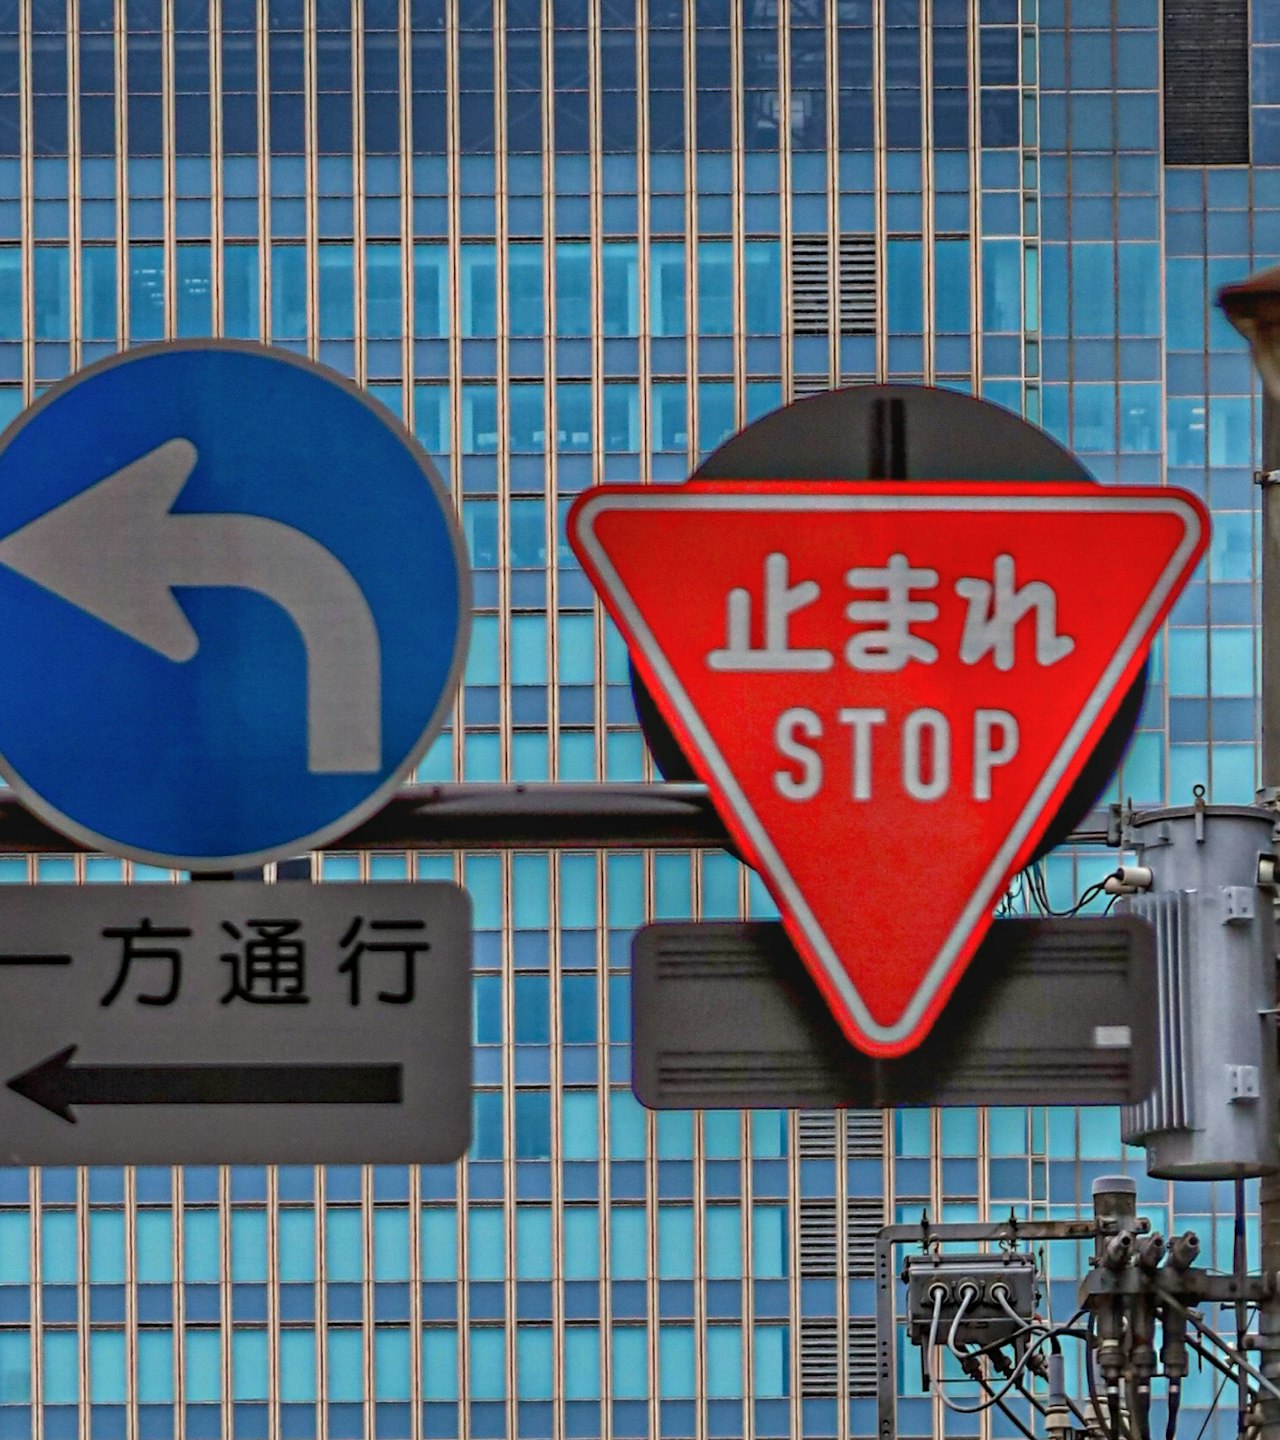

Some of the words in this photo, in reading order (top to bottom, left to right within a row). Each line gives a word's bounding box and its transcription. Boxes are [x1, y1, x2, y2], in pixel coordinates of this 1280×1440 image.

[708, 553, 1074, 672] 止まれ
[773, 708, 1020, 800] STOP
